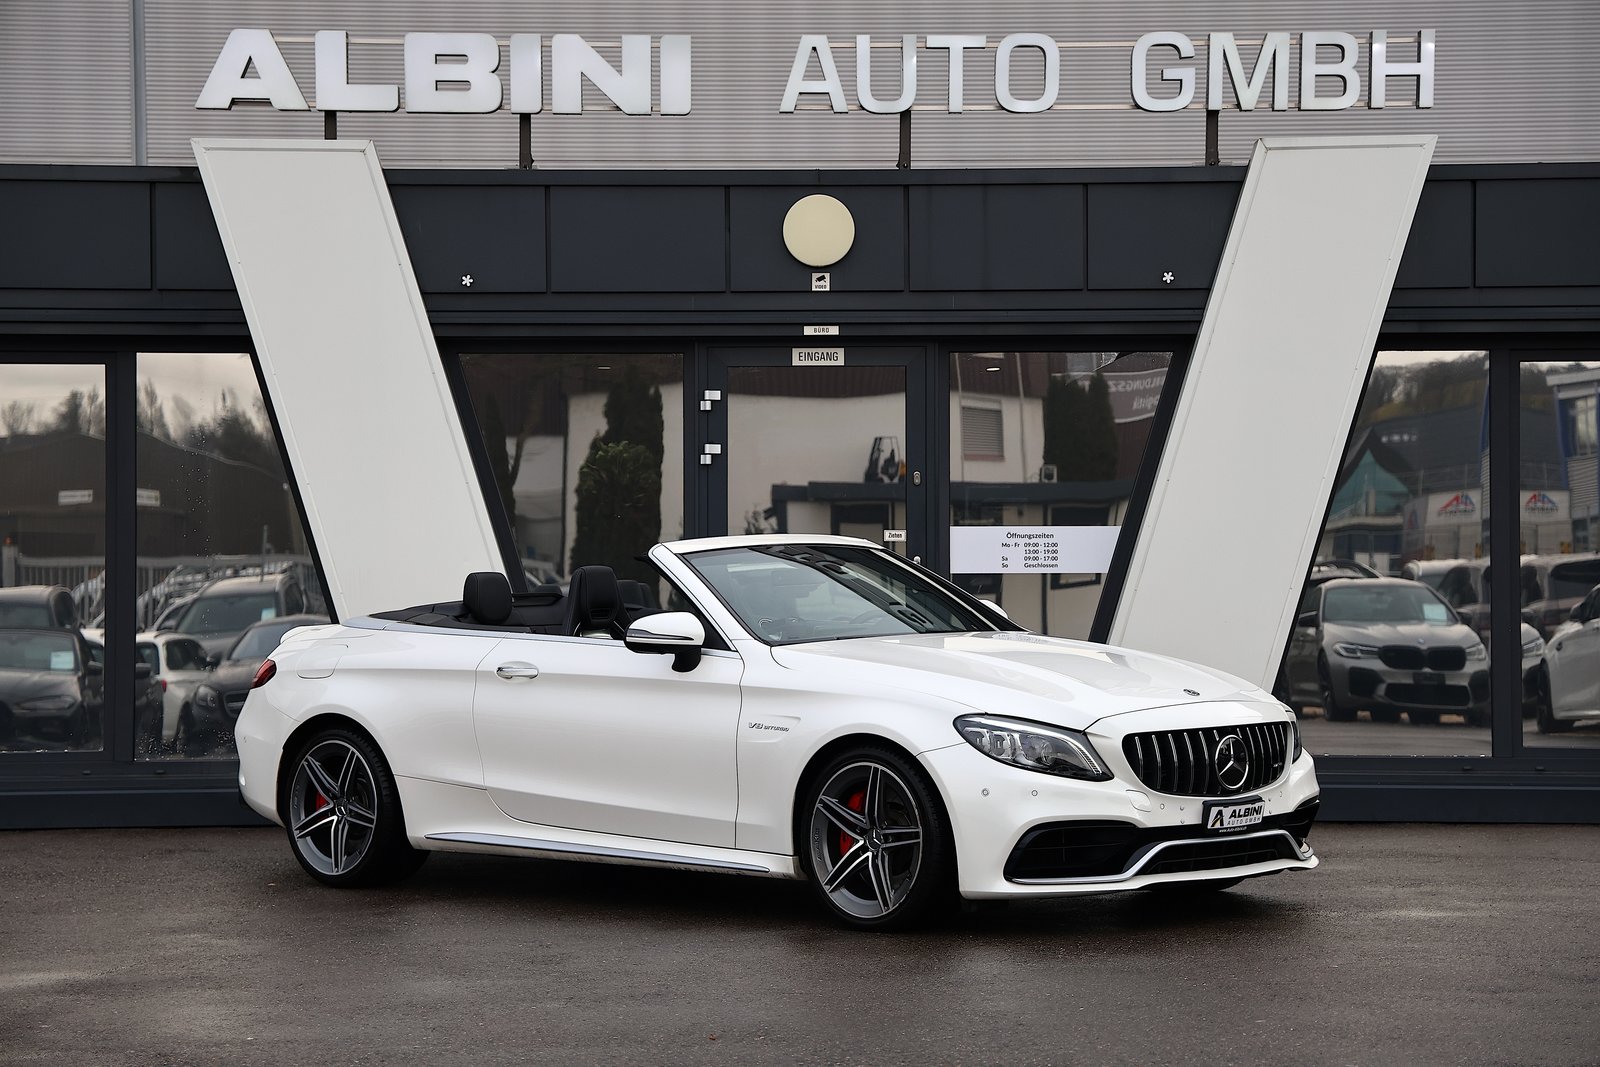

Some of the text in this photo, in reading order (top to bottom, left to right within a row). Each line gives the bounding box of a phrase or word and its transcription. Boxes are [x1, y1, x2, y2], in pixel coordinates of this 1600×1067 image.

[195, 28, 1437, 116] ALBINI AUTO GMBH
[798, 351, 839, 362] EINGANG
[1229, 806, 1262, 819] ALBINI
